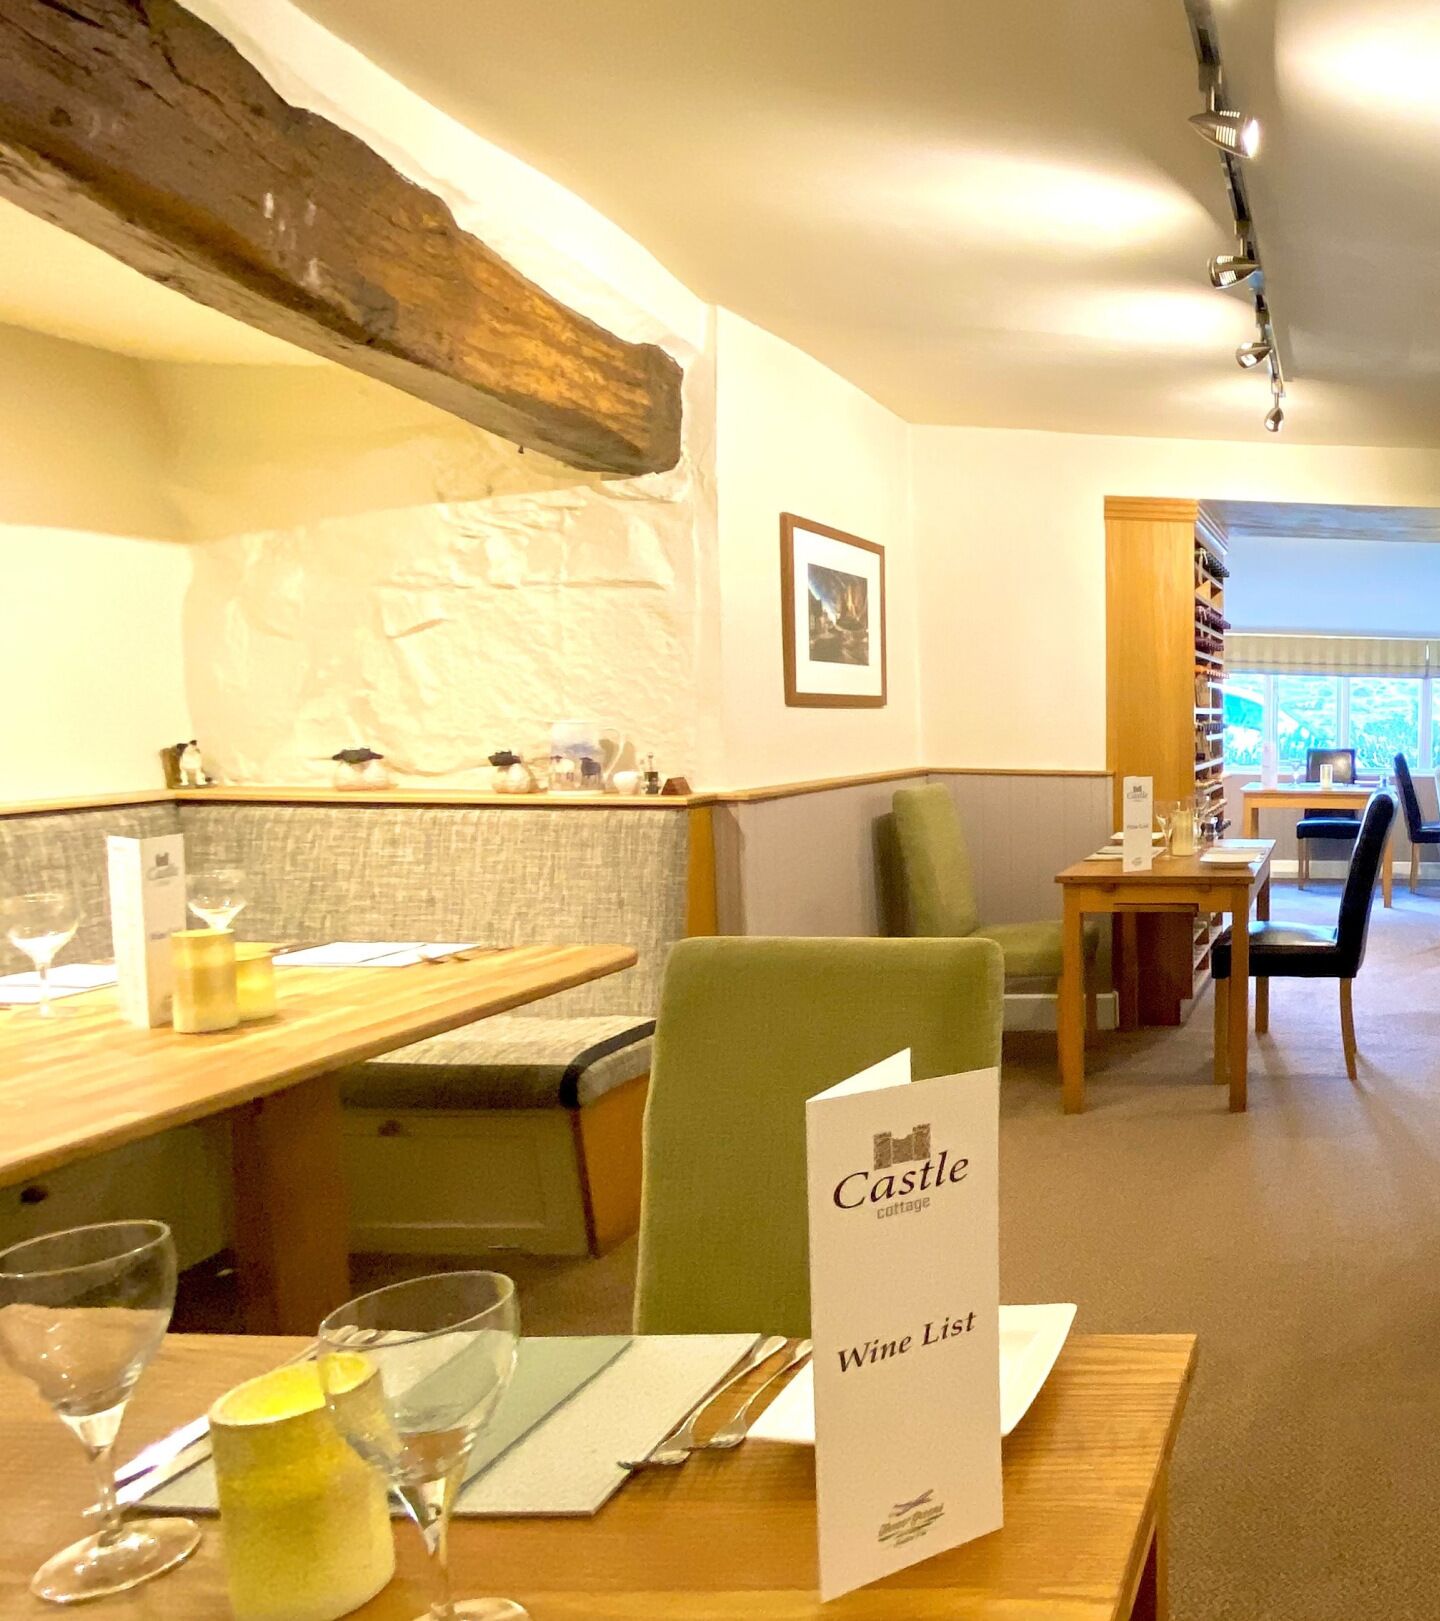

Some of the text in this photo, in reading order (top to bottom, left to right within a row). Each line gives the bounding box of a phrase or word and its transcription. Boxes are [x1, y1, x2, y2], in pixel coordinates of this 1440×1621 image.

[833, 1150, 969, 1210] Castle
[877, 1196, 931, 1220] cottage
[837, 1311, 977, 1373] Wine List
